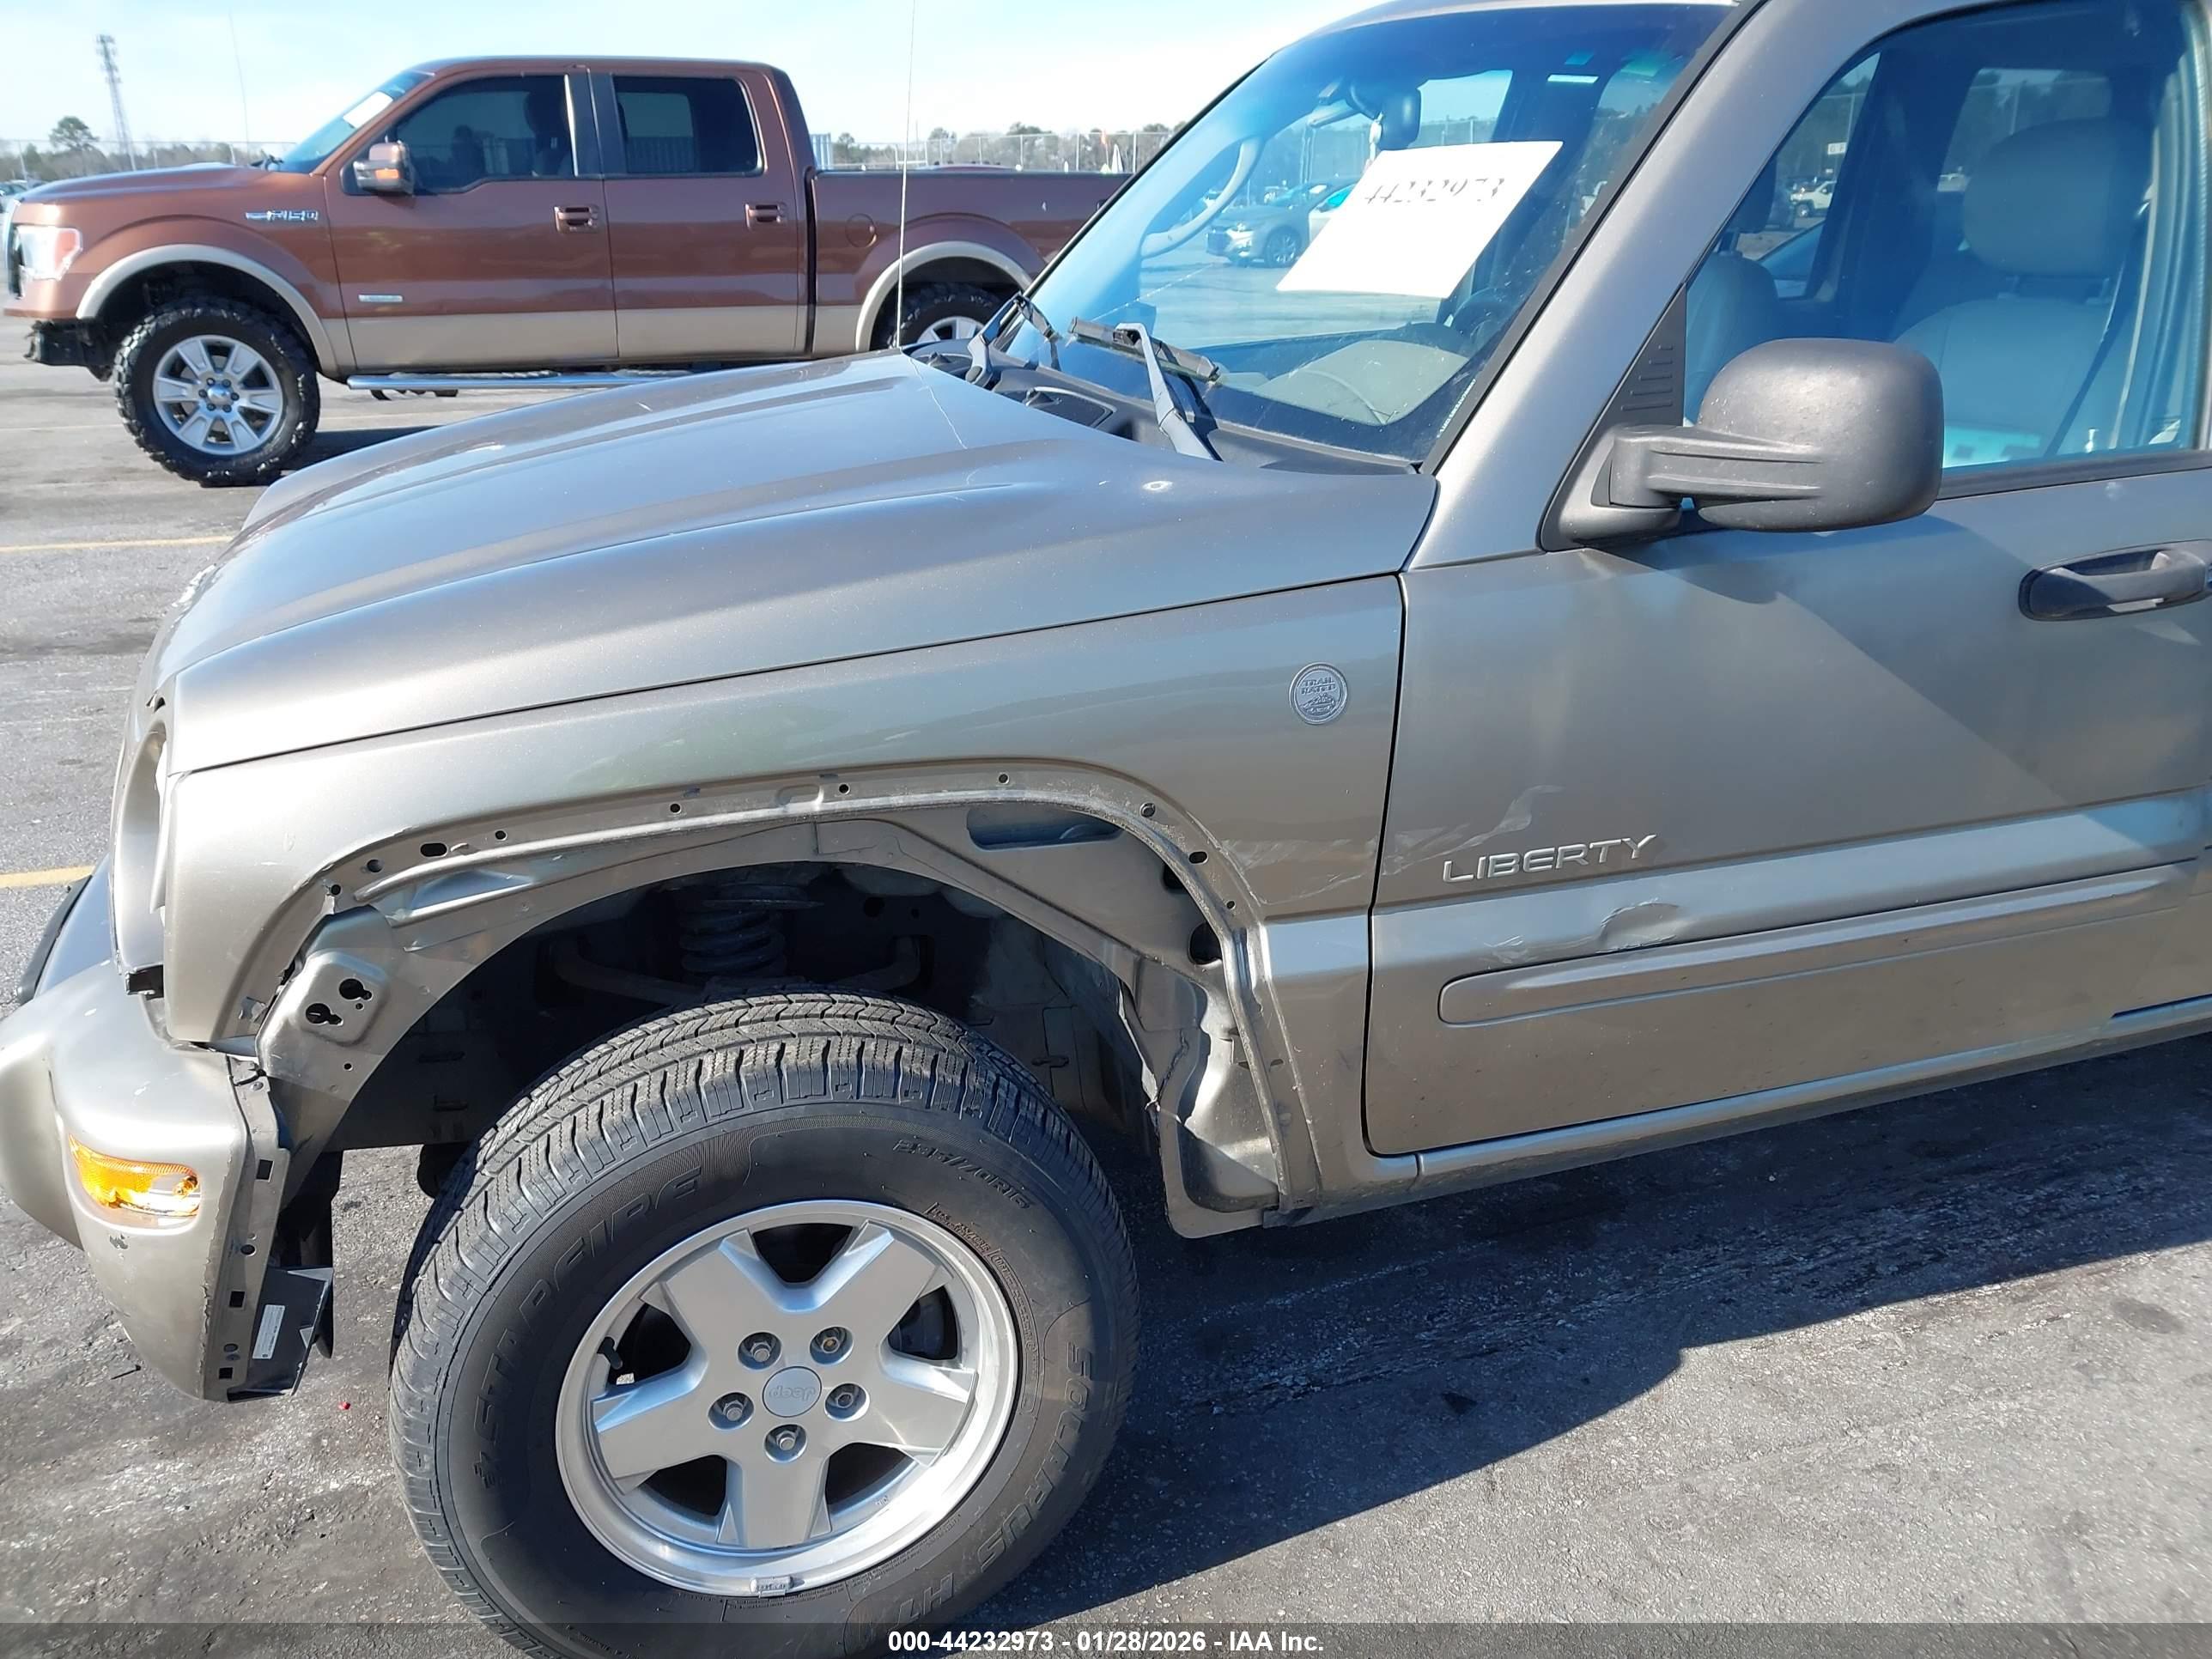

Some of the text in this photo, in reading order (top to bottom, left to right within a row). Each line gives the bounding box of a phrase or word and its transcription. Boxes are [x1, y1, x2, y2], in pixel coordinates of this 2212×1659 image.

[1443, 834, 1657, 883] LIBERTY
[473, 1164, 702, 1445] STARFIRE
[769, 1385, 817, 1401] Jeep
[977, 1342, 1095, 1573] SOLARUS
